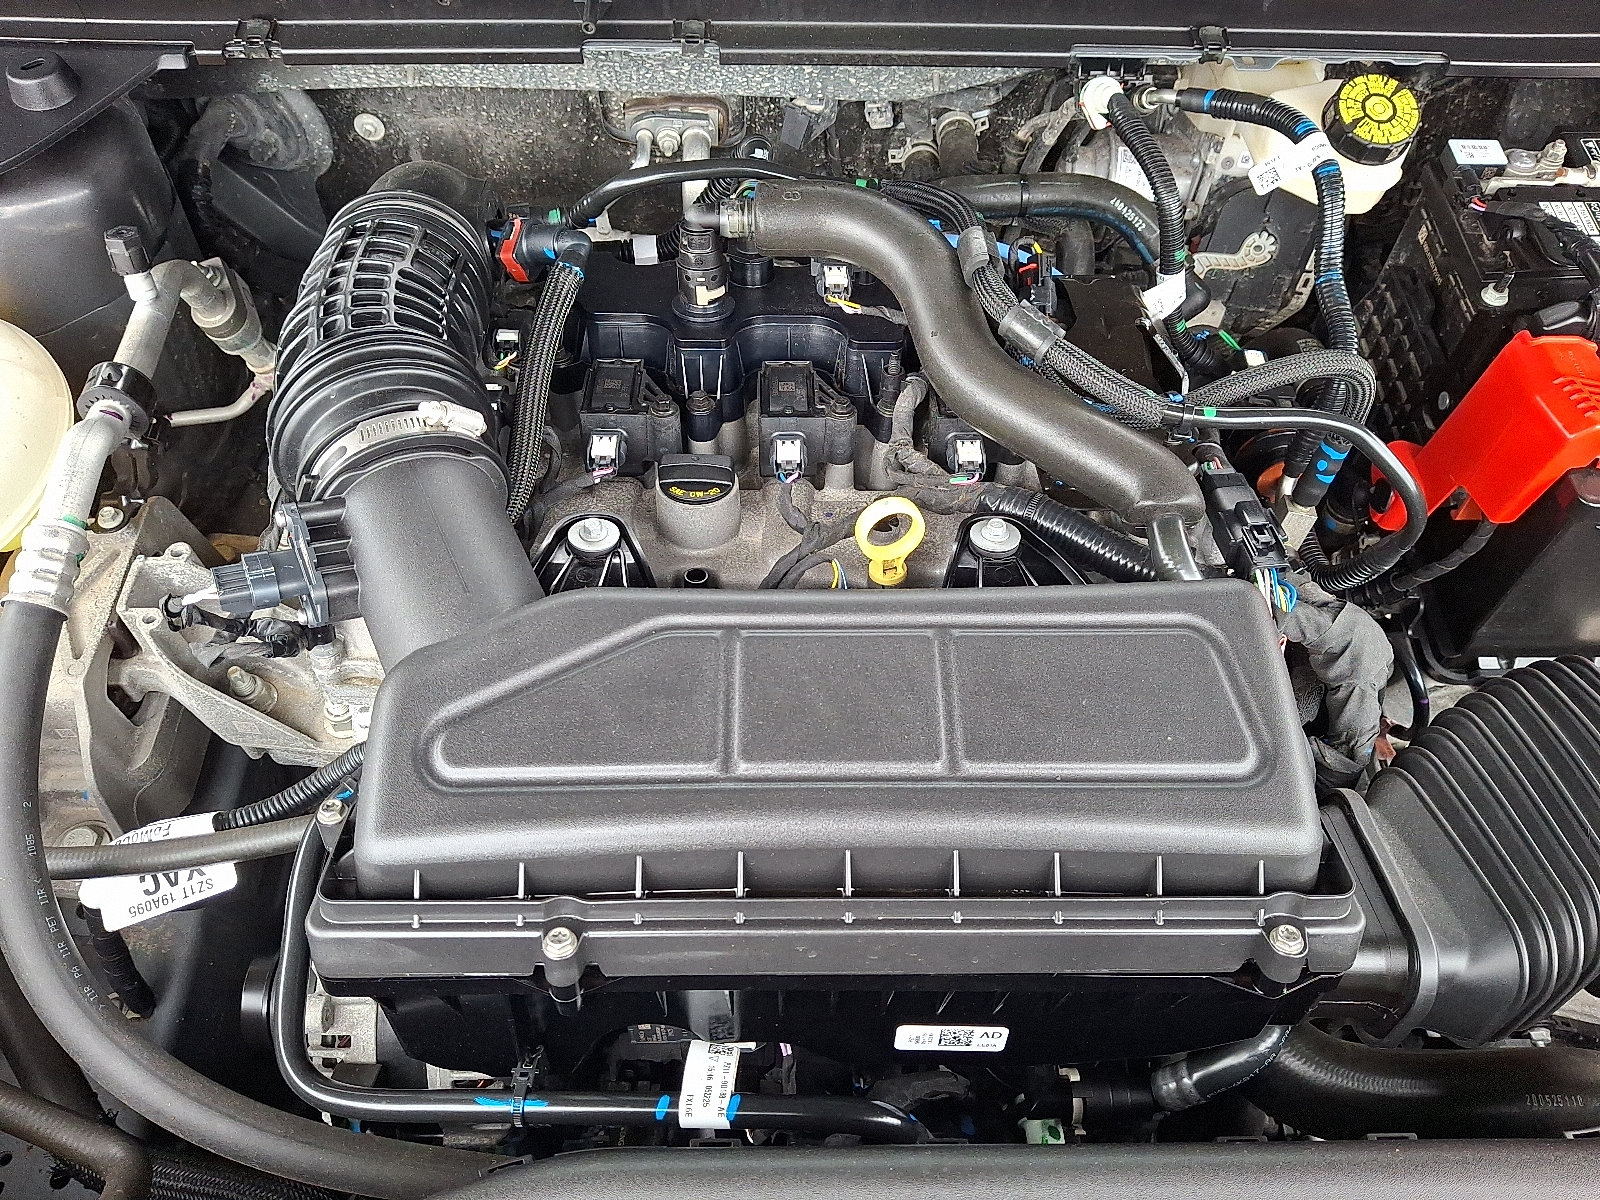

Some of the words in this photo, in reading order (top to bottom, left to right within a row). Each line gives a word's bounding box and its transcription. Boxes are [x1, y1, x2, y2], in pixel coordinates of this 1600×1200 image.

[669, 486, 687, 496] SAE
[689, 487, 721, 498] 0W-20
[25, 833, 37, 857] 1085
[182, 878, 214, 900] SZ1T
[128, 891, 176, 918] 19A095
[45, 916, 59, 933] PET
[979, 1031, 1003, 1040] AD
